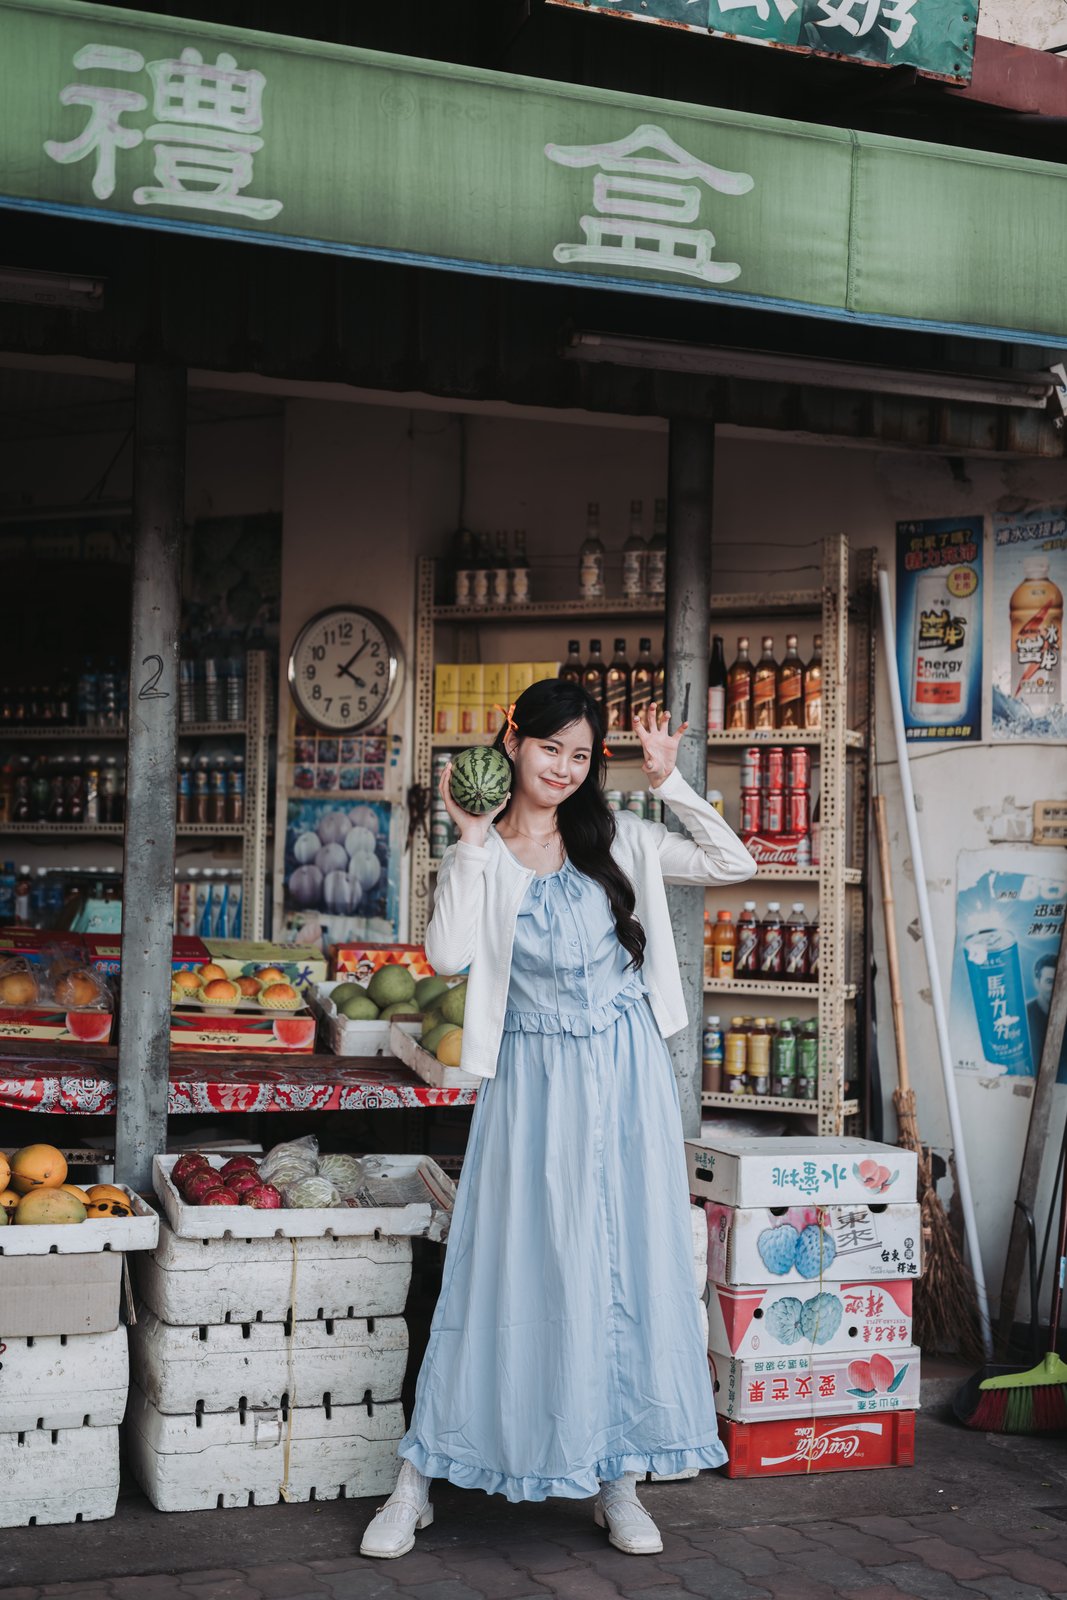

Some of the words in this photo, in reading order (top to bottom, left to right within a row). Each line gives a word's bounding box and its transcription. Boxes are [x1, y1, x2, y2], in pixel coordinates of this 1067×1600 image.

[42, 43, 284, 221] 禮
[544, 124, 755, 284] 盒
[324, 630, 336, 645] 11
[338, 622, 353, 639] 12
[312, 645, 325, 660] 10
[370, 642, 380, 657] 2
[306, 664, 316, 680] 9
[375, 661, 385, 677] 3
[917, 656, 964, 679] Energy
[924, 669, 951, 680] Drink
[138, 654, 170, 700] 2
[312, 684, 322, 700] 8
[370, 683, 379, 697] 4
[324, 697, 333, 712] 7
[340, 702, 350, 718] 6
[358, 697, 367, 712] 5
[1033, 904, 1064, 918] 迅速
[772, 1161, 847, 1195] 水蜜桃
[881, 1249, 900, 1263] 台東
[845, 1289, 884, 1318] 釋迦
[862, 1326, 909, 1343] 台東名產
[754, 1359, 809, 1372] 特選分級品
[748, 1374, 836, 1403] 愛文芒果
[794, 1434, 860, 1461] Coca-Cola
